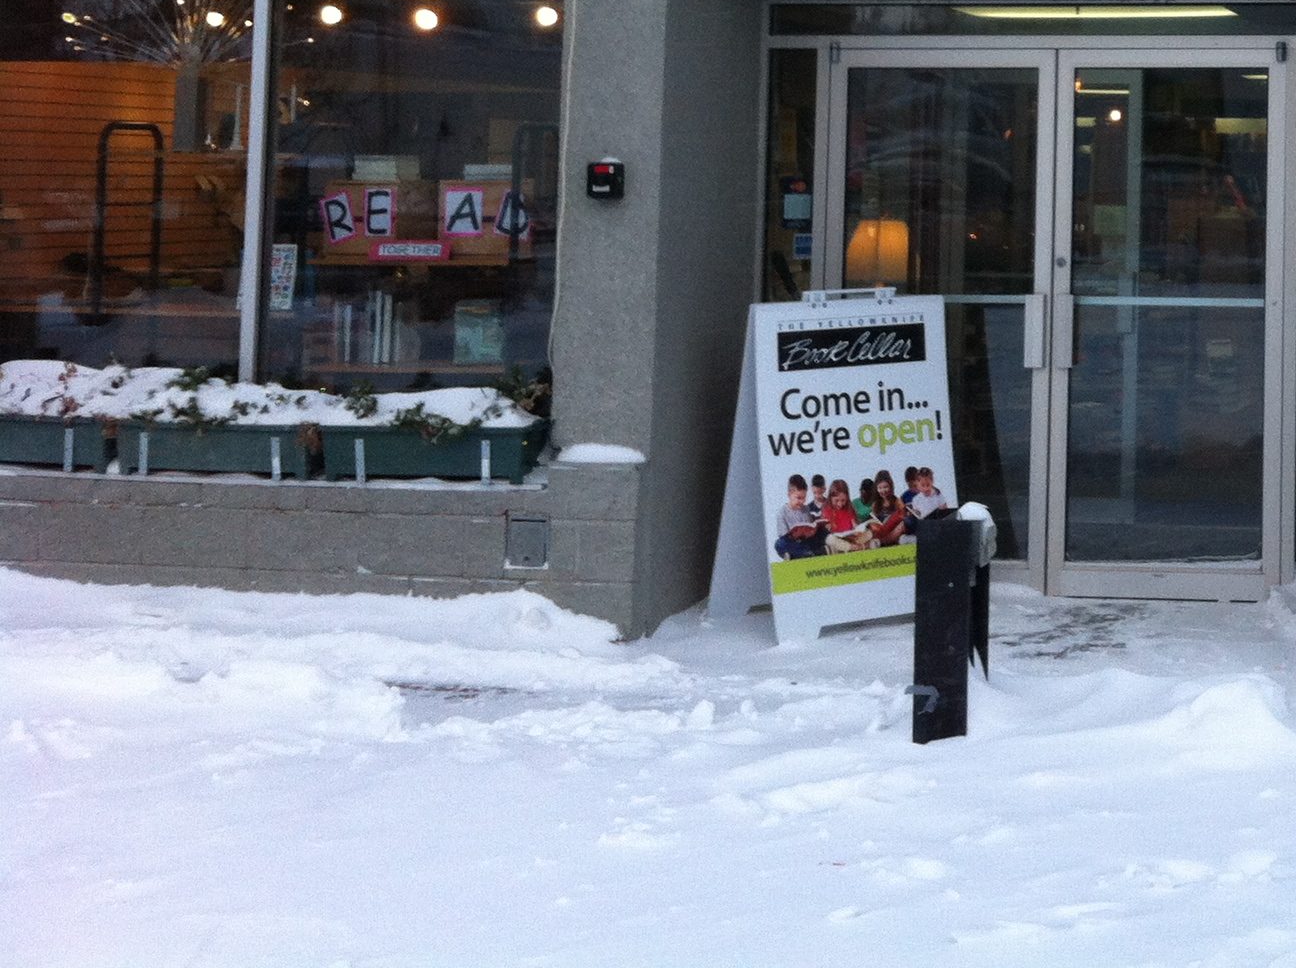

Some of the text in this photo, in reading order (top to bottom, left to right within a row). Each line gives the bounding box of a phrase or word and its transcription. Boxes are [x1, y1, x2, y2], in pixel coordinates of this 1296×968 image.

[782, 330, 912, 370] Book Cellar
[780, 380, 929, 420] Come in...
[768, 410, 943, 457] we're open!
